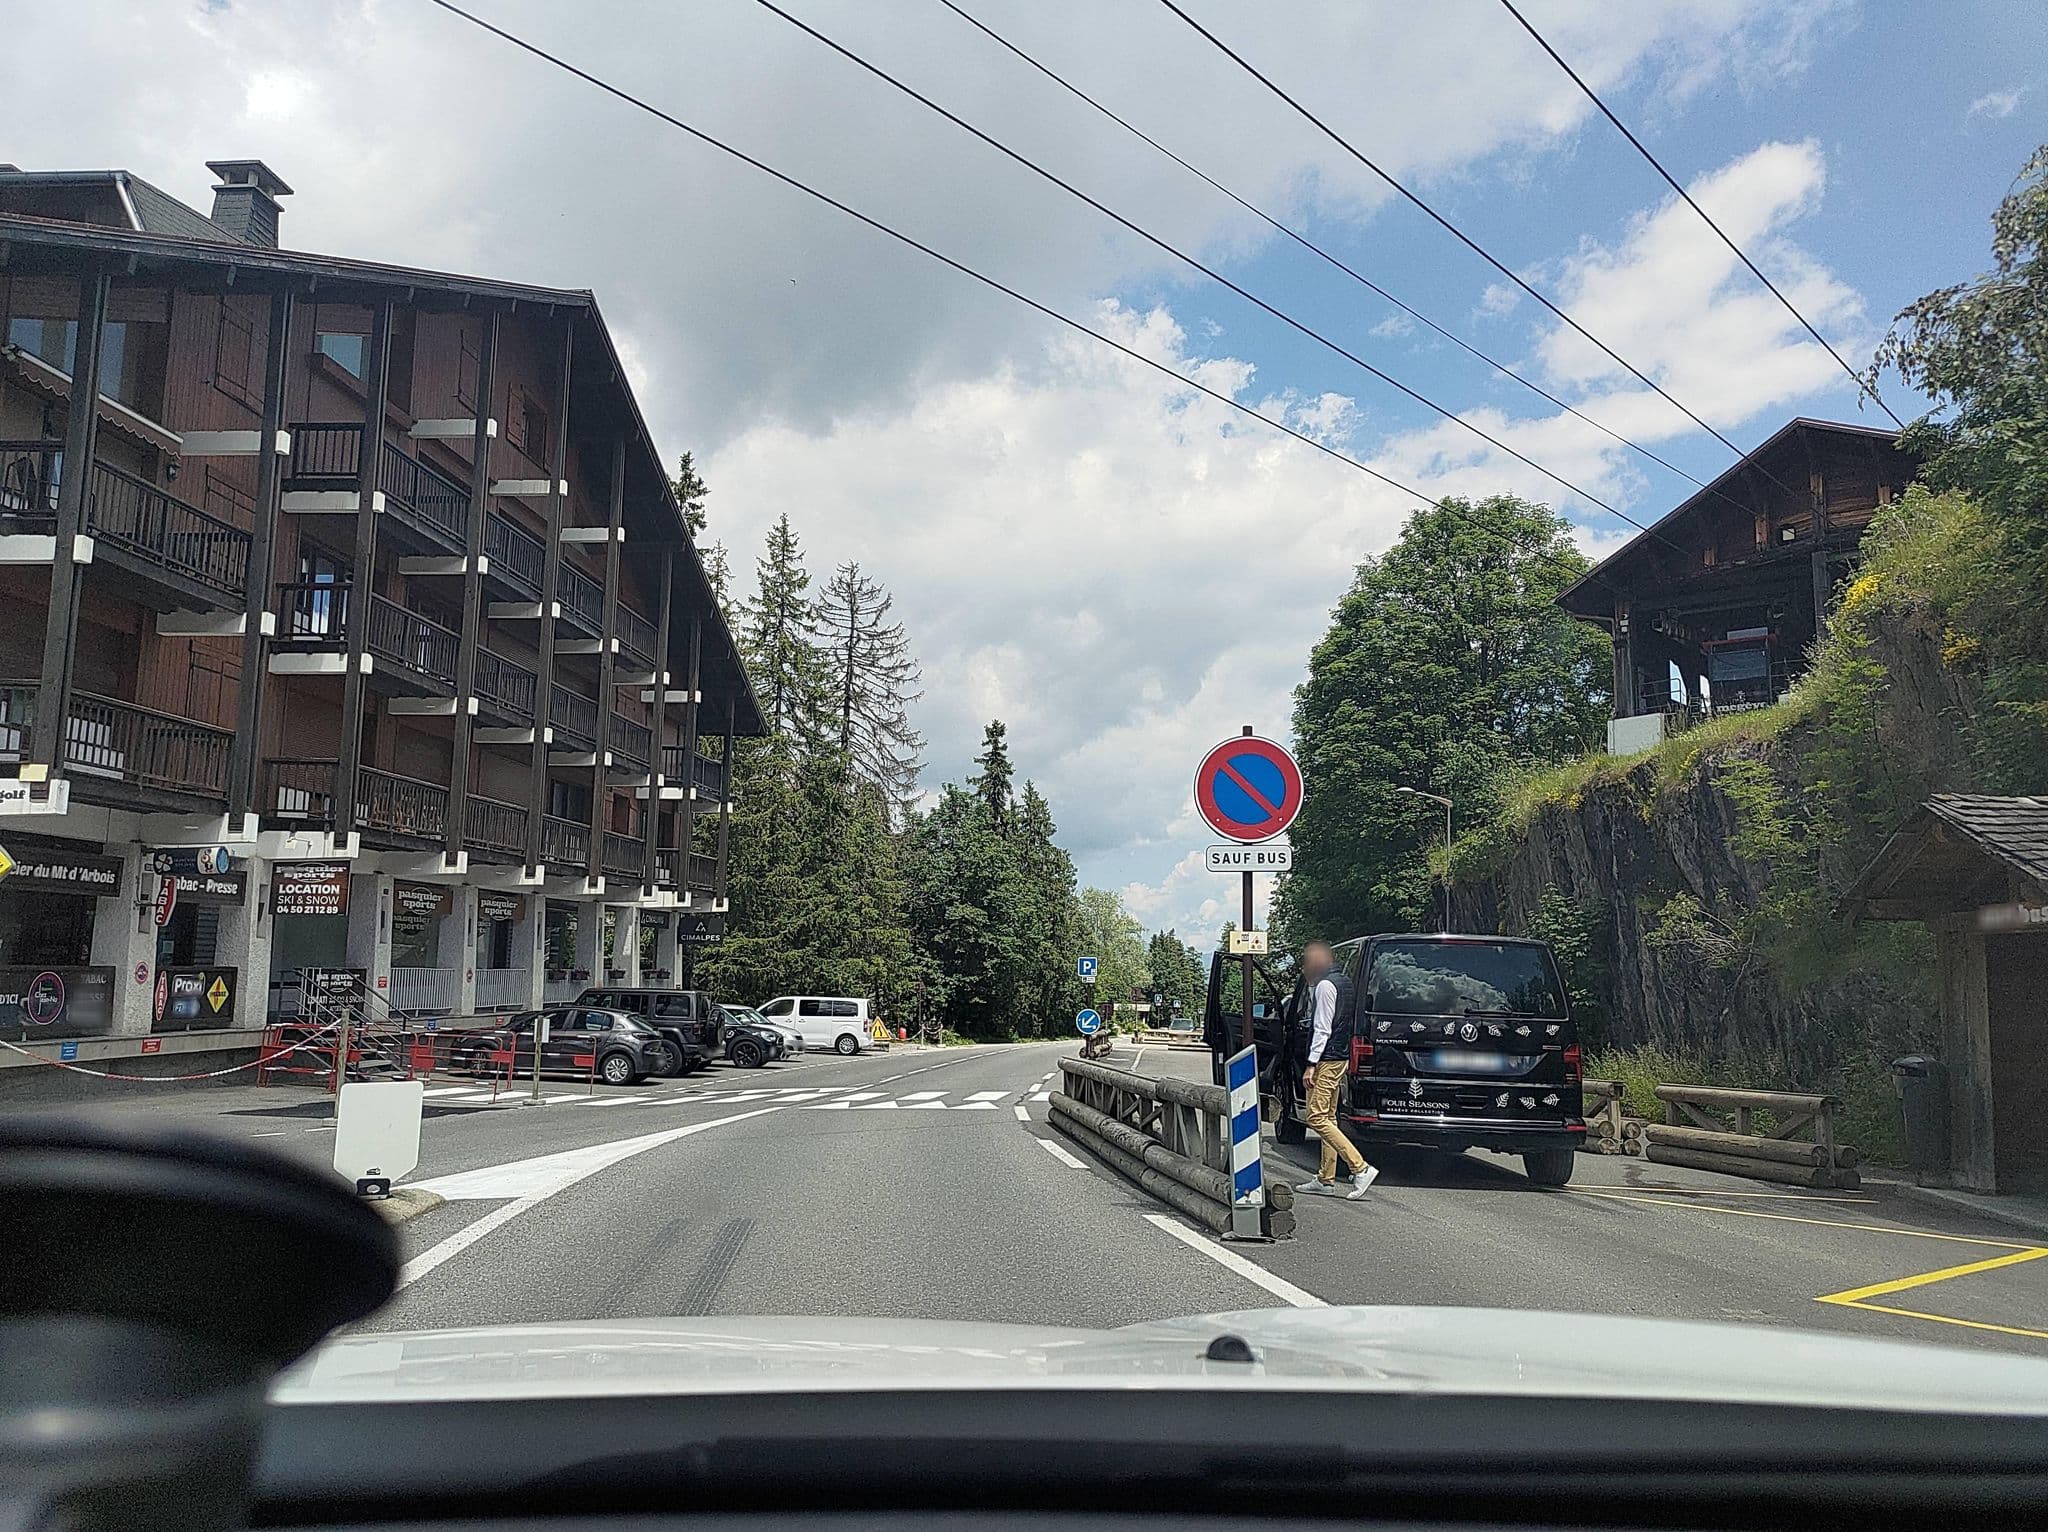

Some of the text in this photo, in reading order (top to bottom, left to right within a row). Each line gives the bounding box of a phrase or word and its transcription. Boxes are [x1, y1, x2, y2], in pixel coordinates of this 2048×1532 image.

[1212, 852, 1287, 865] SAUF BUS
[33, 863, 50, 878] du
[51, 865, 67, 880] Mt
[206, 879, 238, 894] Presse
[279, 884, 340, 894] LOCATION
[155, 879, 171, 923] TABAC
[278, 895, 339, 905] SKI & SNOW
[398, 891, 443, 902] pasquier
[403, 900, 436, 911] sports
[481, 898, 518, 909] pasquier
[277, 906, 338, 914] 04 50 21 12 89
[485, 907, 512, 917] sports
[174, 977, 203, 993] Proxi
[1408, 1100, 1450, 1109] SEASONS
